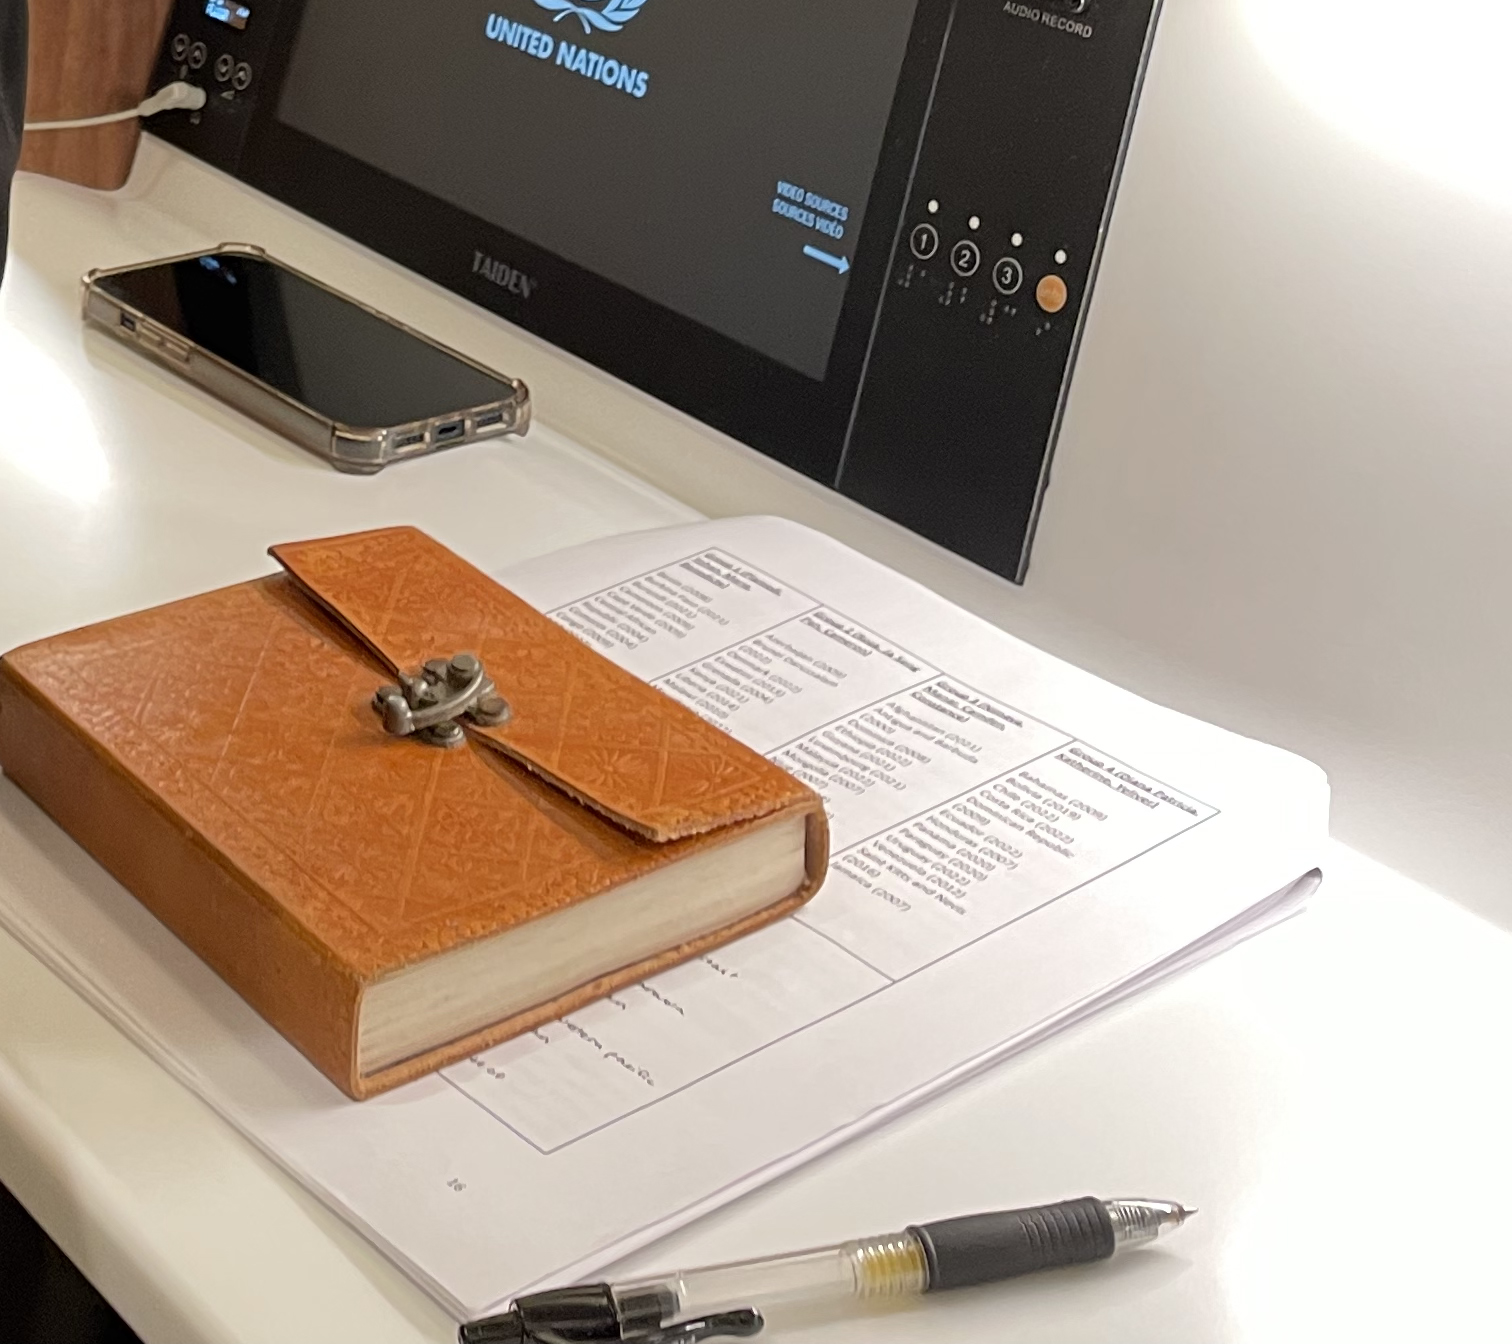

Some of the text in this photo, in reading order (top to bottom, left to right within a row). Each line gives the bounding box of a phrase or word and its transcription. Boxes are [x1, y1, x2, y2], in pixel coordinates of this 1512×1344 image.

[1003, 1, 1093, 38] AUDIO RECORD
[485, 13, 650, 98] UNITED NATIONS
[777, 180, 848, 221] VIDEO SOURCES
[772, 198, 815, 227] SOURCES
[920, 233, 928, 250] 1
[958, 249, 971, 268] 2
[1001, 266, 1013, 285] 3
[980, 790, 1010, 809] Costa
[993, 784, 1020, 801] Chile
